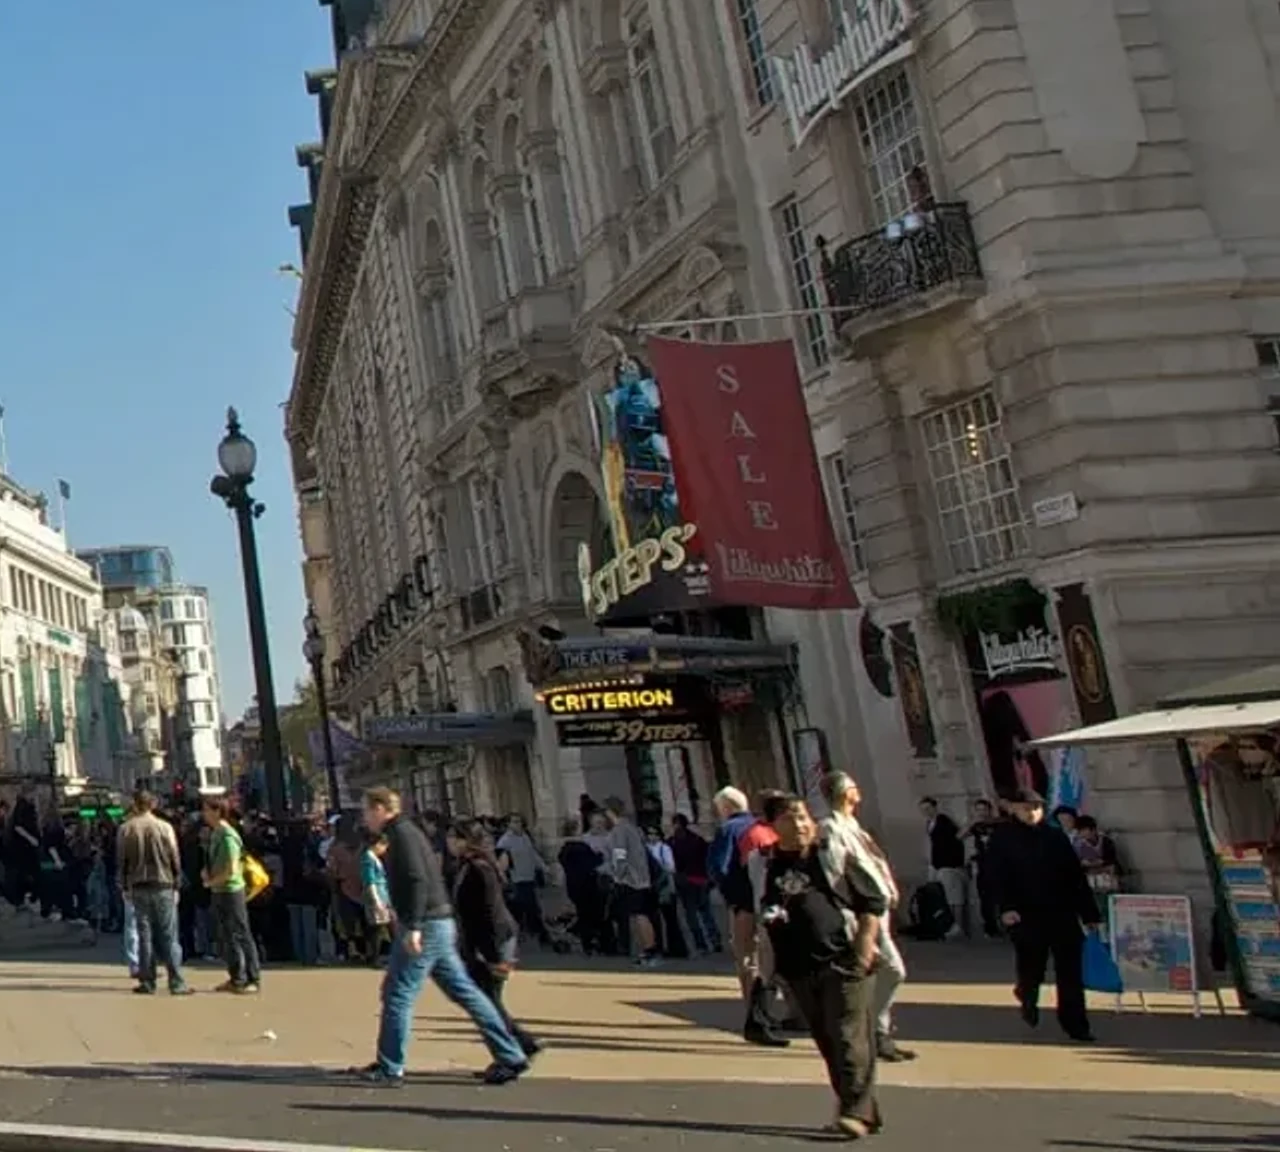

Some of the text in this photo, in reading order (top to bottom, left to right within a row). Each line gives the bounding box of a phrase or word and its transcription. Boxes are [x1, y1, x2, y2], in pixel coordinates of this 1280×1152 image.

[715, 363, 779, 531] SALE
[563, 649, 629, 669] THEATRE
[549, 689, 674, 712] CRITERION
[610, 719, 645, 742] 39
